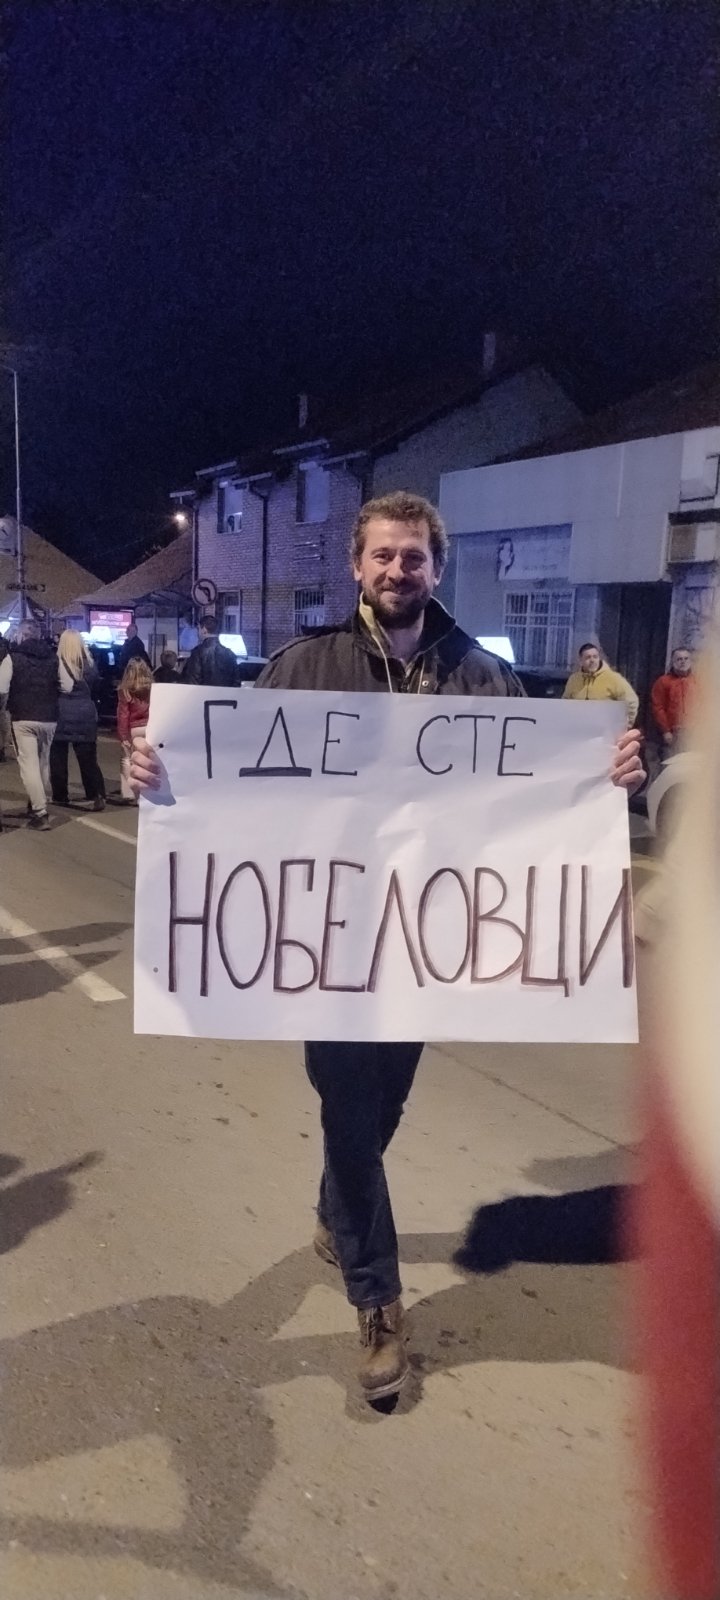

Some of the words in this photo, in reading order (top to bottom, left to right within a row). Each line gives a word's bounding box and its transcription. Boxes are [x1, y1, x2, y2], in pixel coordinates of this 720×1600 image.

[203, 700, 360, 779] ГДЕ
[416, 714, 537, 776] СТЕ
[168, 851, 635, 997] НОБЕЛОВЦИ
